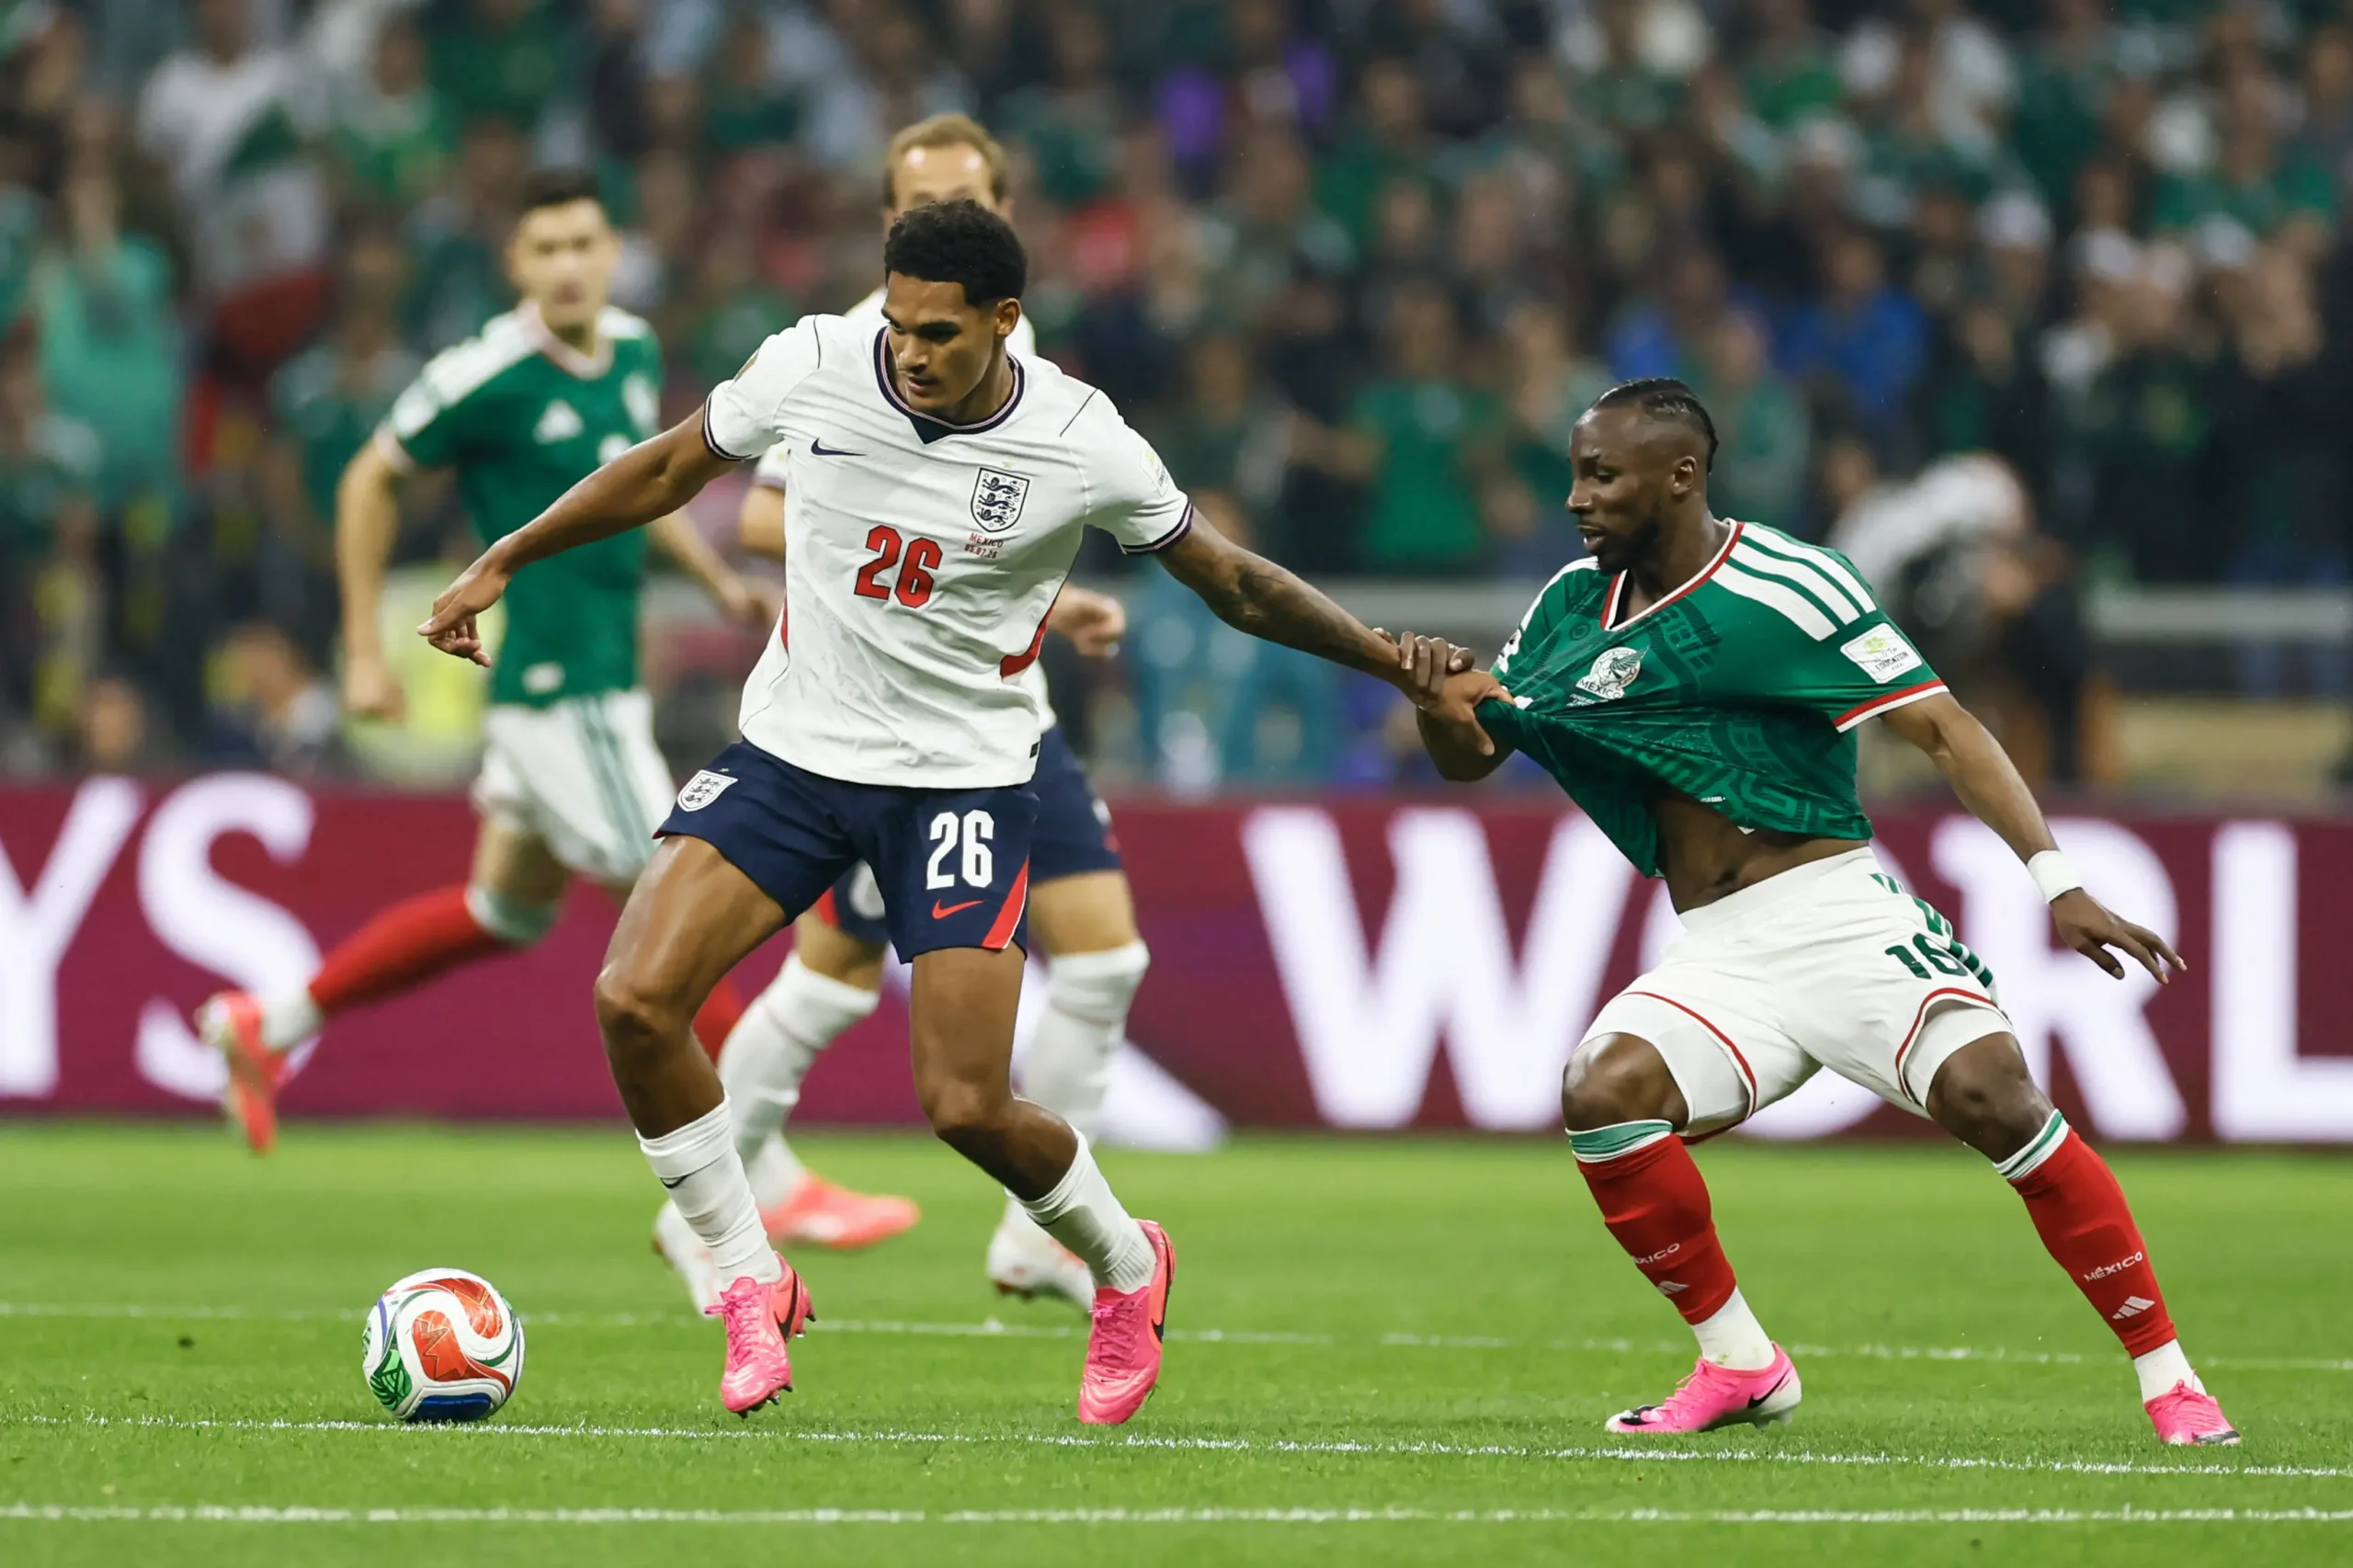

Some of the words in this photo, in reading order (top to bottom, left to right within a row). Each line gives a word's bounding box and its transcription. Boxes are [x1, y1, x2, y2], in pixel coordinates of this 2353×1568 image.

[969, 532, 1005, 549] MEXICO
[854, 525, 942, 608] 26
[1875, 651, 1909, 671] EDUCATION
[1579, 679, 1621, 699] MÉXICO
[926, 809, 995, 890] 26
[1884, 933, 1969, 980] 16
[2083, 1250, 2143, 1282] MÉXICO
